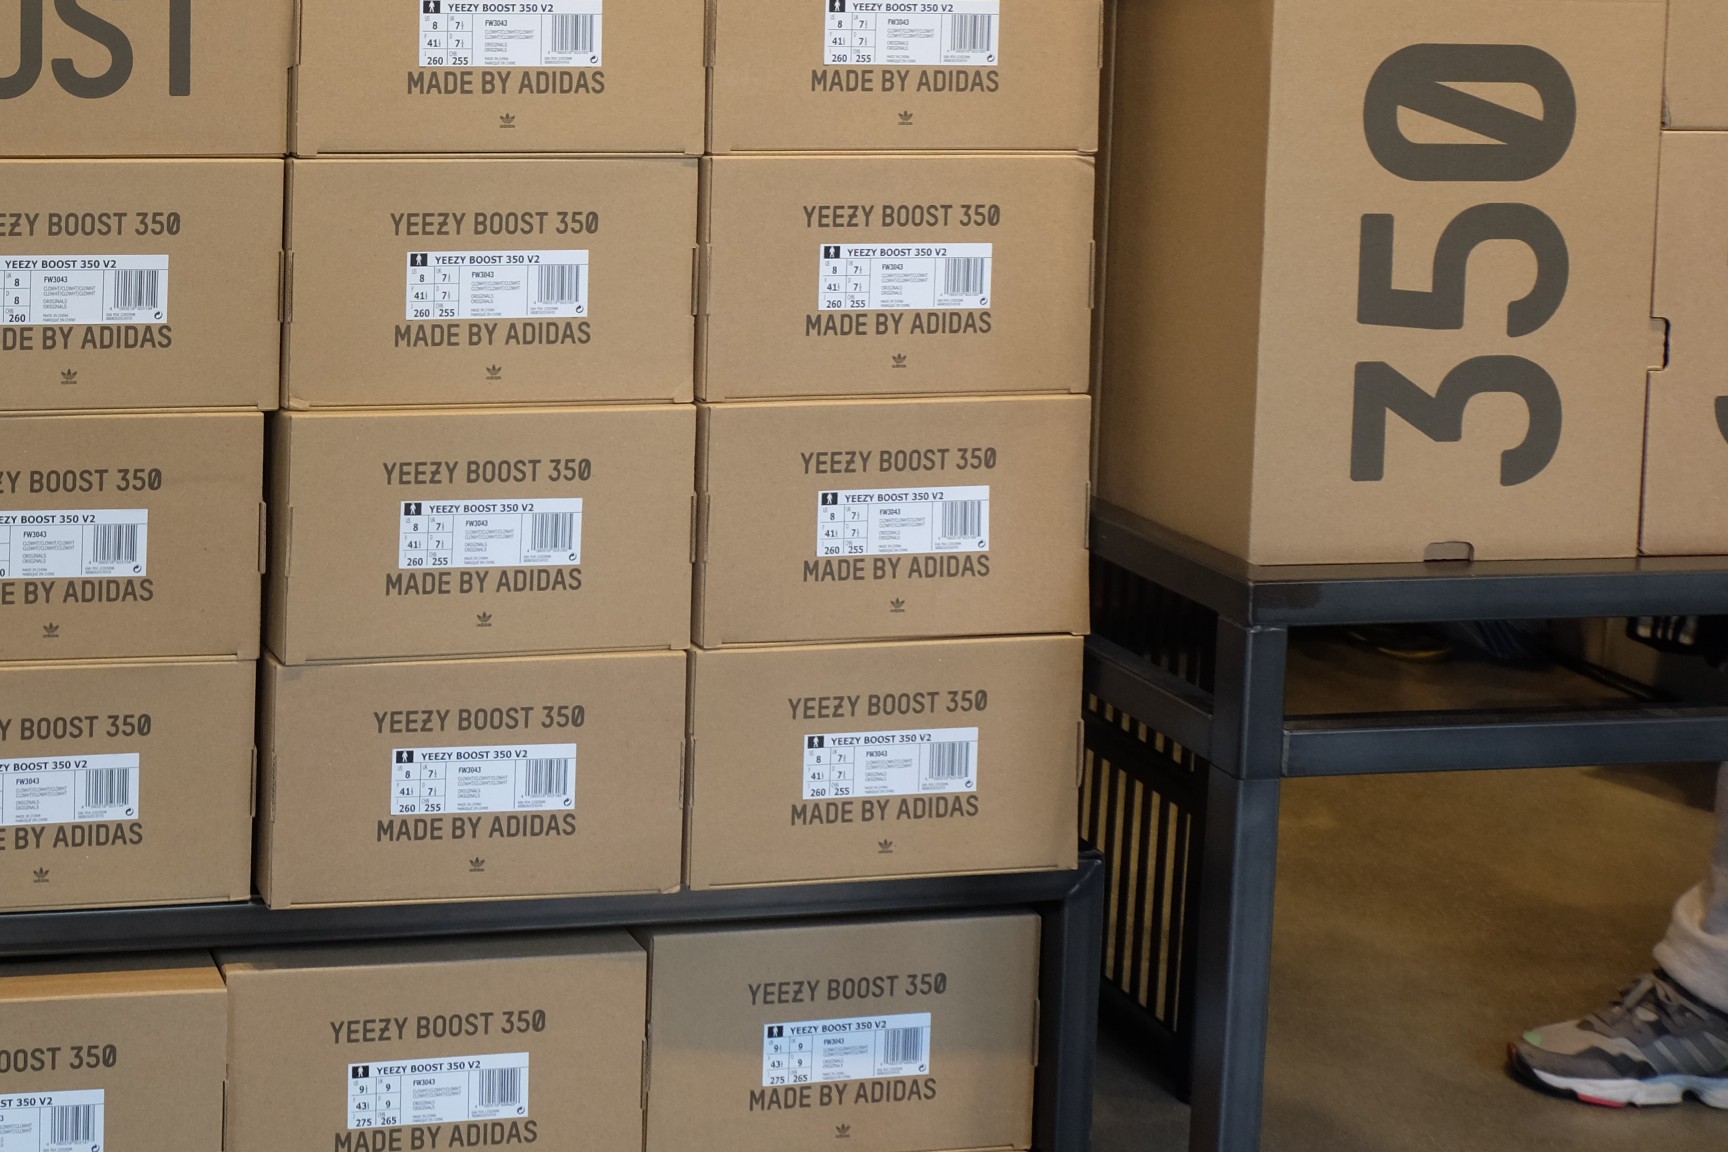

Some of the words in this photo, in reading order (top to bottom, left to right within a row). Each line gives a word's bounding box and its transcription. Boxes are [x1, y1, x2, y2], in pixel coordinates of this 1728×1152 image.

[448, 4, 479, 12] YEEZY
[483, 4, 516, 12] BOOST
[520, 4, 538, 12] 350
[541, 4, 553, 12] V2
[48, 213, 127, 236] BOOST
[135, 212, 180, 235] 350
[391, 213, 465, 235] YEEZY
[474, 212, 548, 235] BOOST
[556, 212, 598, 234] 350
[803, 205, 874, 227] YEEZY
[882, 205, 952, 227] BOOST
[960, 204, 1000, 226] 350
[1350, 43, 1577, 487] 350
[43, 327, 73, 350] BY
[81, 325, 171, 349] ADIDAS
[383, 462, 458, 485] YEEZY
[467, 460, 541, 483] BOOST
[549, 459, 591, 481] 350
[801, 451, 871, 474] YEEZY
[880, 449, 949, 472] BOOST
[956, 447, 996, 469] 350
[30, 469, 108, 493] BOOST
[117, 468, 161, 491] 350
[804, 559, 864, 582] MADE
[873, 558, 900, 579] BY
[908, 555, 989, 578] ADIDAS
[789, 696, 860, 719] YEEZY
[868, 692, 939, 715] BOOST
[946, 690, 987, 712] 350
[21, 716, 98, 740] BOOST
[107, 714, 151, 737] 350
[374, 710, 449, 733] YEEZY
[459, 707, 533, 730] BOOST
[542, 705, 584, 728] 350
[422, 752, 453, 761] YEEZY
[456, 751, 490, 760] BOOST
[493, 750, 512, 758] 350
[515, 750, 528, 758] V2
[749, 981, 819, 1004] YEEZY
[828, 975, 898, 1000] BOOST
[906, 973, 946, 995] 350
[331, 1017, 407, 1044] YEEZY
[417, 1013, 493, 1038] BOOST
[502, 1010, 545, 1033] 350
[790, 1026, 819, 1035] YEEZY
[822, 1023, 852, 1032] BOOST
[856, 1022, 872, 1030] 350
[874, 1021, 887, 1029] V2
[70, 1045, 116, 1069] 350
[16, 1098, 36, 1107] 350
[39, 1097, 53, 1106] V2
[750, 1086, 811, 1111] MADE
[820, 1084, 847, 1106] BY
[855, 1078, 936, 1103] ADIDAS
